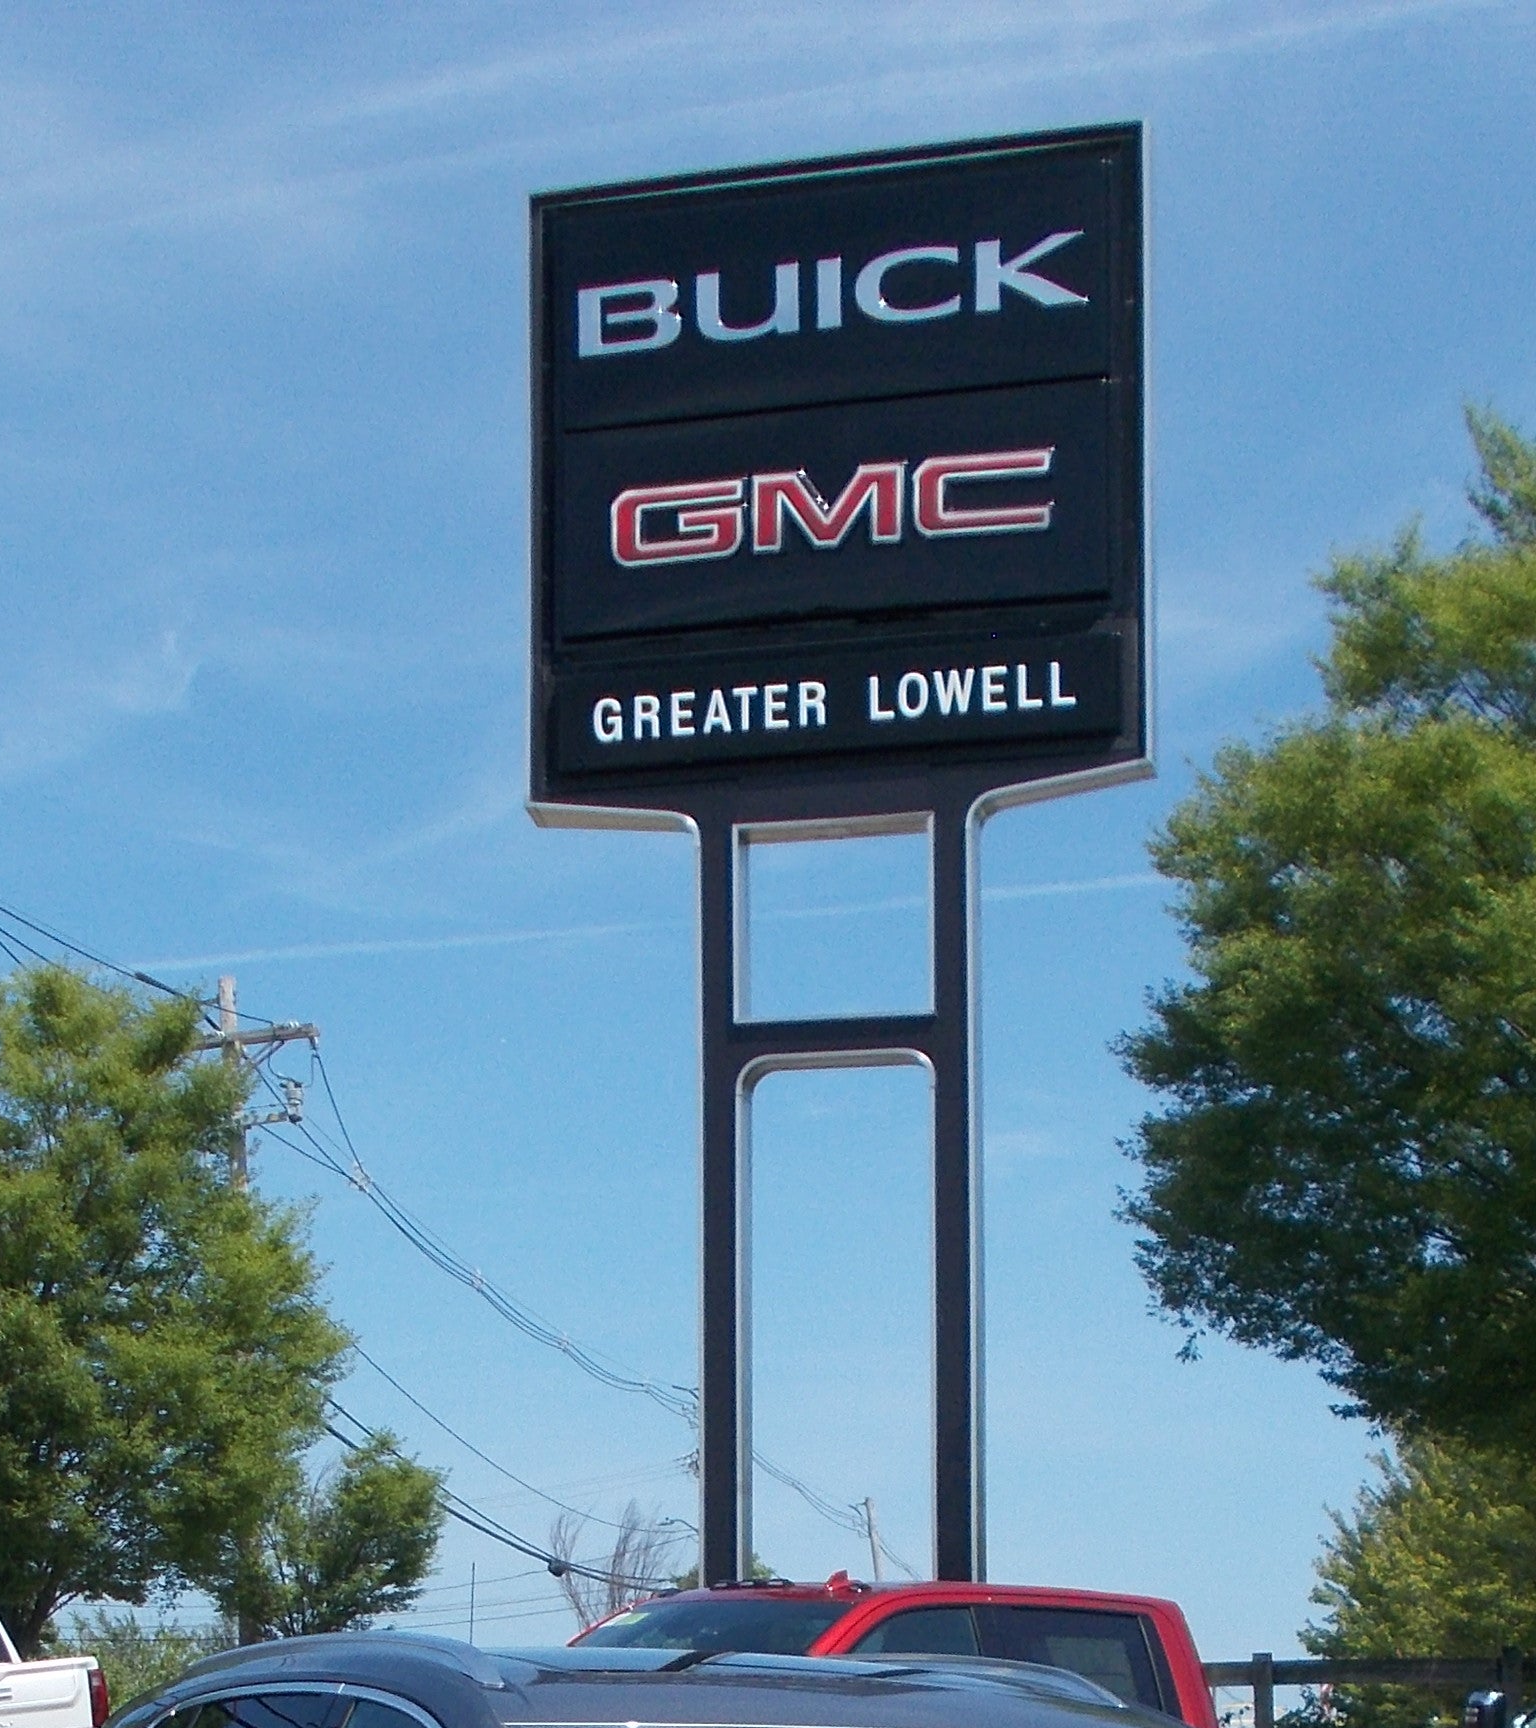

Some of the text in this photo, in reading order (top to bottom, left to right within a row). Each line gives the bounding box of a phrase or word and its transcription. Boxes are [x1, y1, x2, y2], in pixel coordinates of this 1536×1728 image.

[576, 229, 1090, 358] BUICK
[610, 446, 1056, 568] GMC
[592, 660, 1078, 743] GREATER LOWELL
